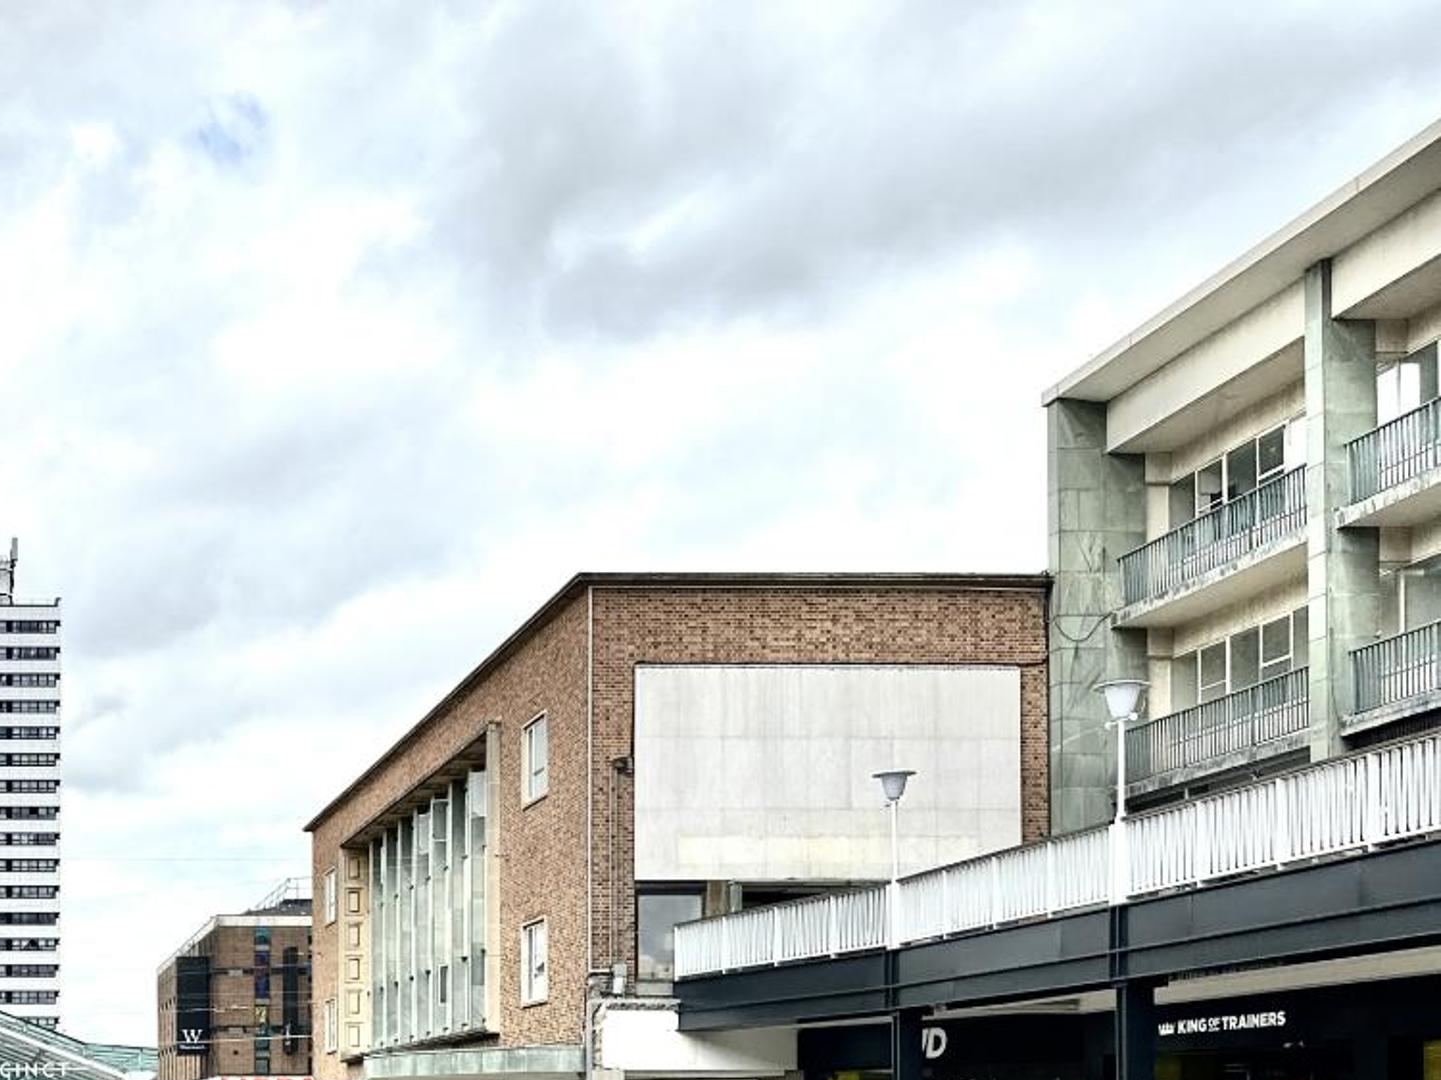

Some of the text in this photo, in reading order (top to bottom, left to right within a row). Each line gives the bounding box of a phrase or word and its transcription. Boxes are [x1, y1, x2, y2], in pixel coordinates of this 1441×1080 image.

[1177, 1010, 1286, 1034] KING OF TRAINERS
[181, 1028, 203, 1044] W
